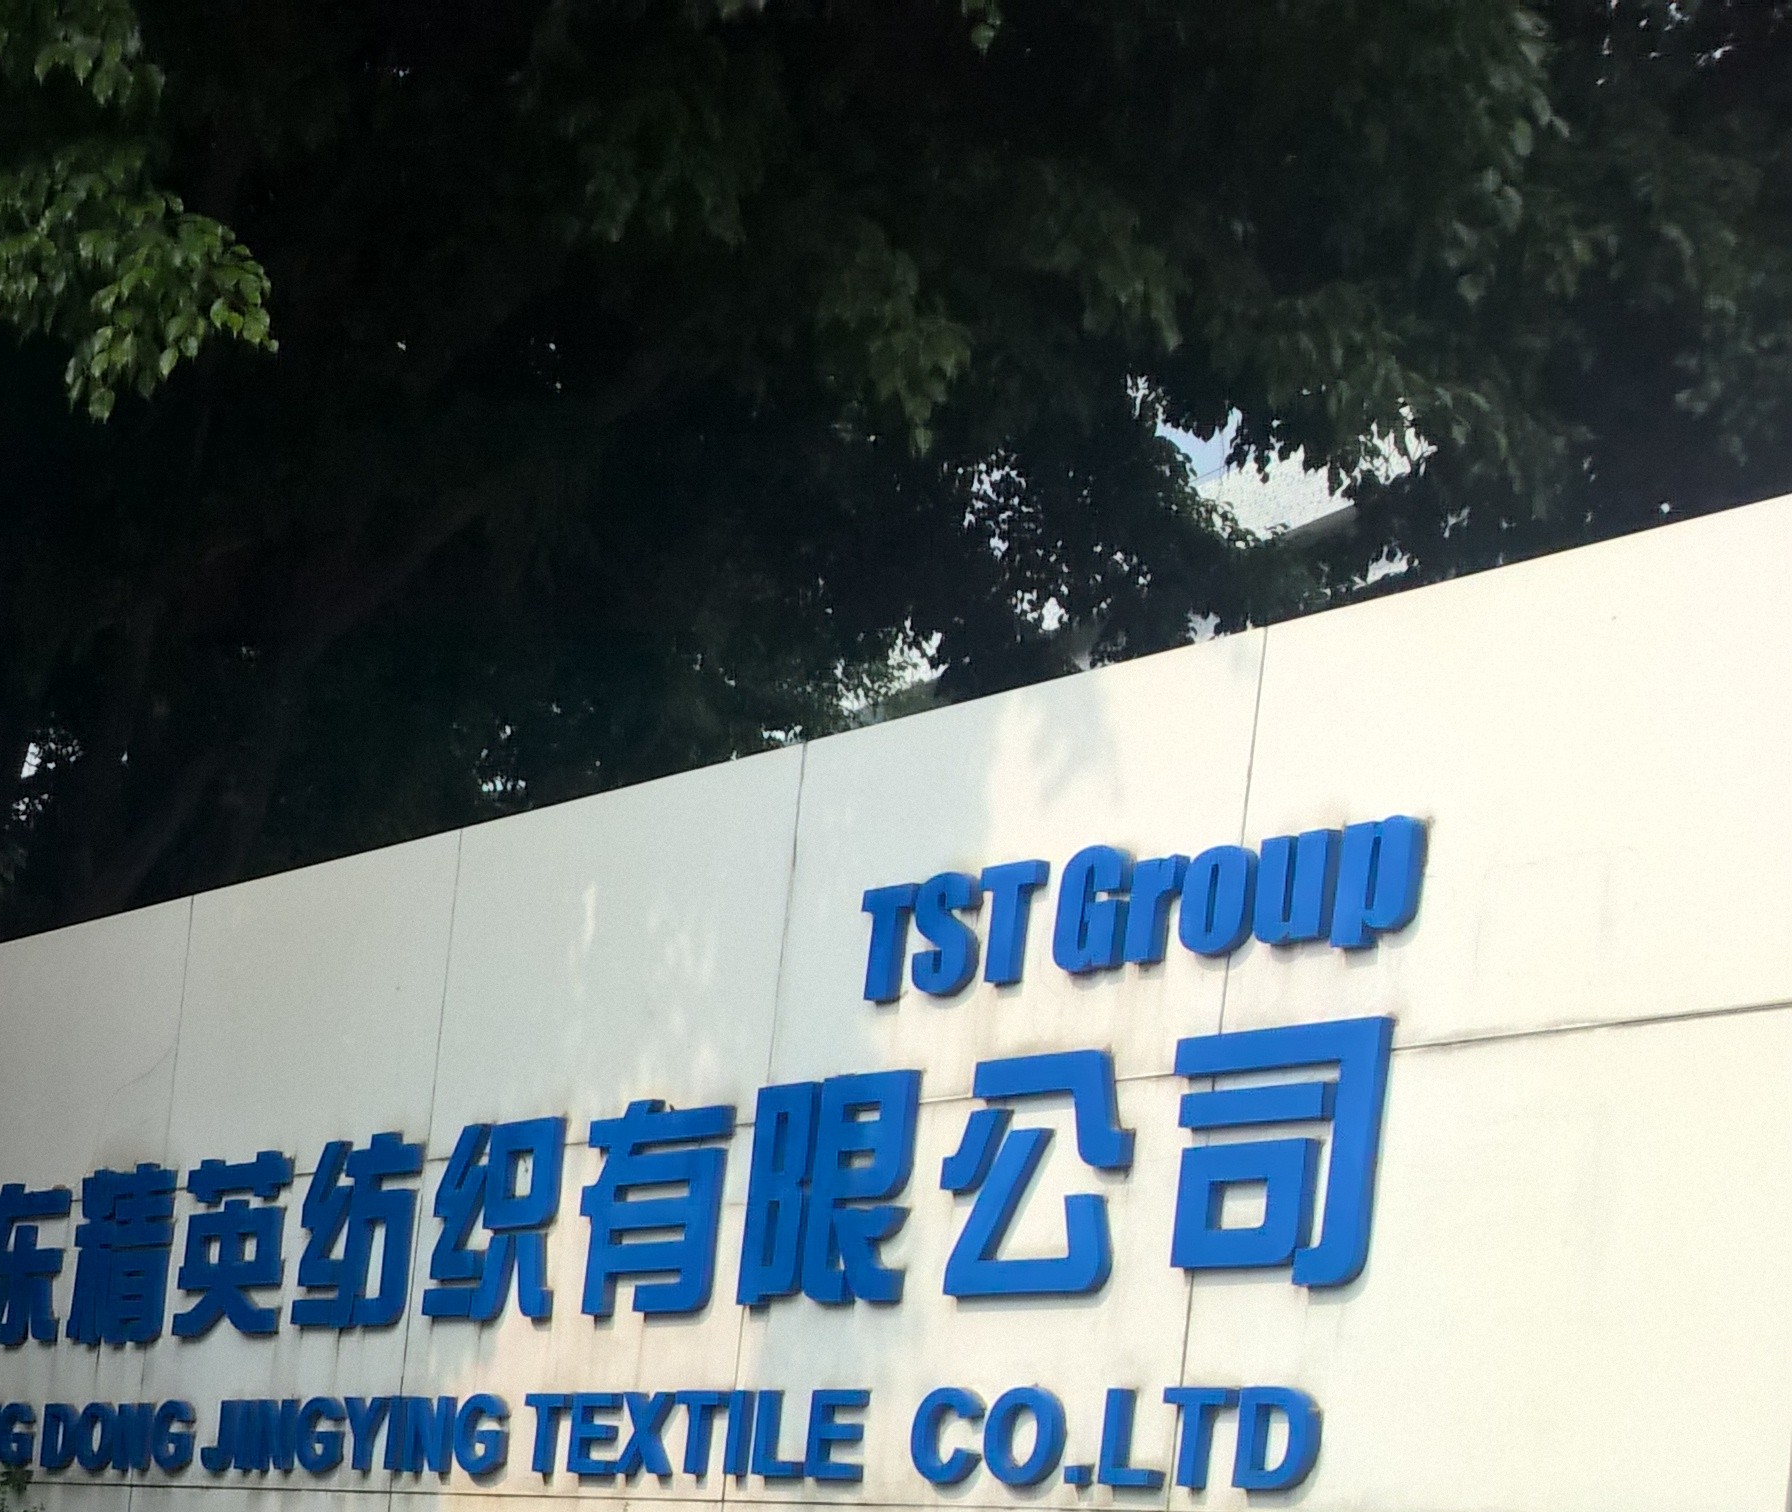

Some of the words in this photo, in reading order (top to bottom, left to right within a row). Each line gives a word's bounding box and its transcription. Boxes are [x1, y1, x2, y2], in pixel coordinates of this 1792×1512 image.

[861, 859, 1050, 1004] TST
[1052, 814, 1430, 976] Group
[39, 1397, 197, 1474] DONG
[199, 1392, 513, 1477] JINGYING
[524, 1388, 871, 1484] TEXTILE
[909, 1385, 1322, 1492] CO.LTD
